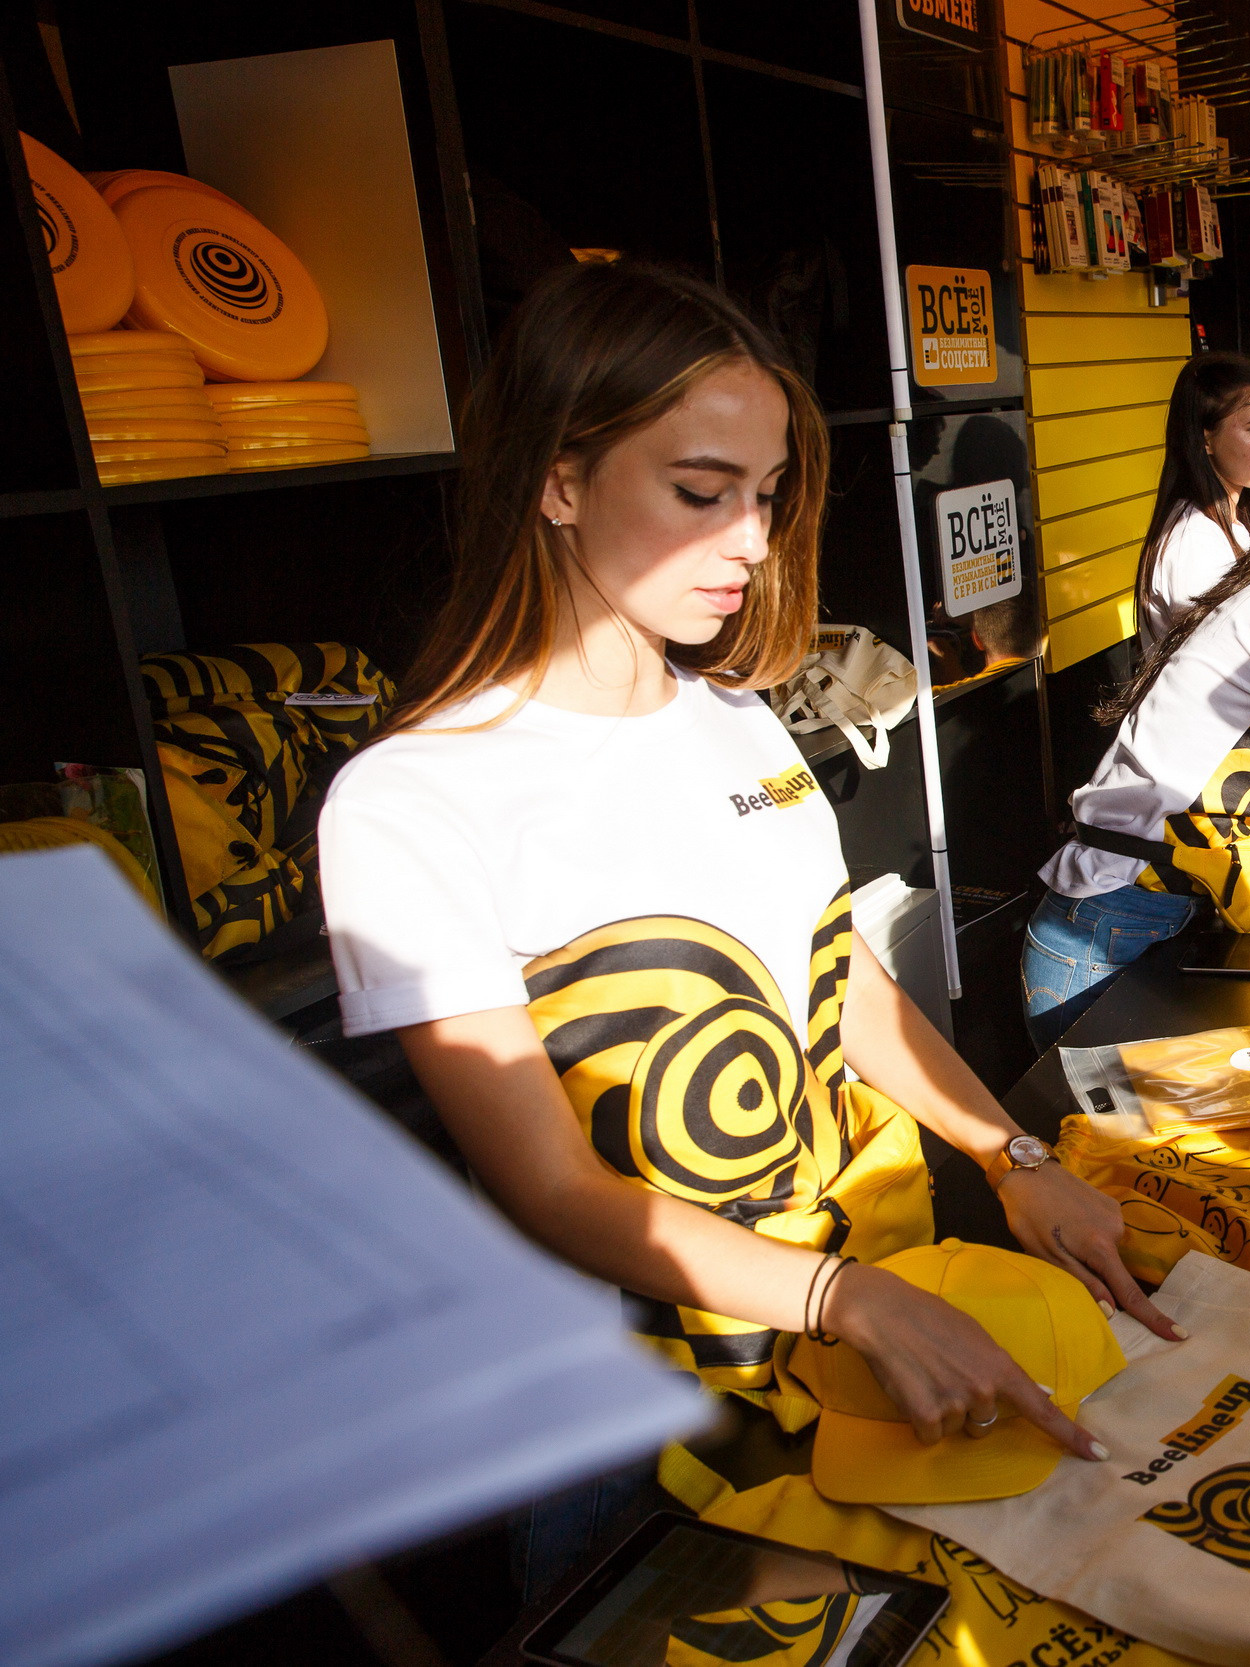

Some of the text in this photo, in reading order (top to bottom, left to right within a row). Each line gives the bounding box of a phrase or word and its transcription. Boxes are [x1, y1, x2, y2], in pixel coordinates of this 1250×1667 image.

[918, 275, 972, 335] ВСЁ
[941, 350, 989, 372] СОЦСЕТИ
[948, 494, 999, 560] ВСЁ
[951, 553, 996, 574] БЕЗЛИМИТНЫЕ
[953, 565, 997, 586] МУЗЫКАЛЬНЫЕ
[954, 575, 998, 600] СЕРВИСЫ
[728, 770, 815, 817] Beelineup
